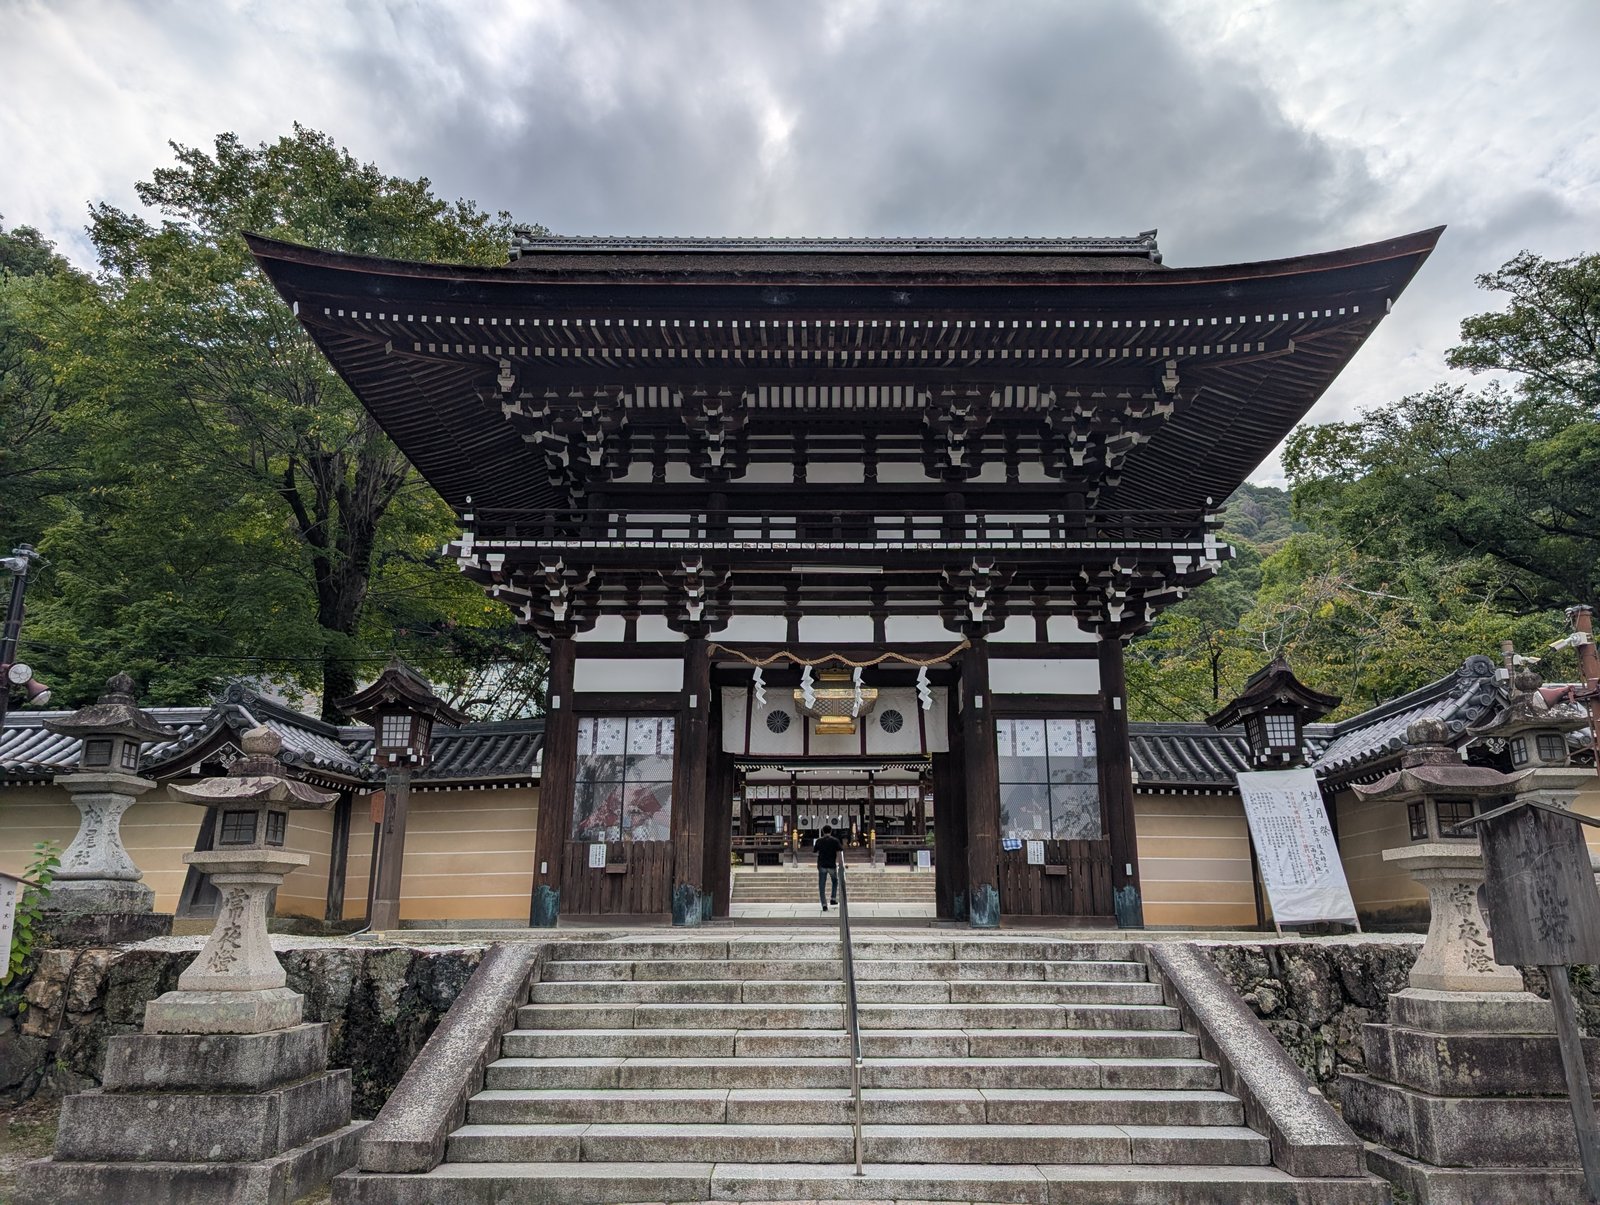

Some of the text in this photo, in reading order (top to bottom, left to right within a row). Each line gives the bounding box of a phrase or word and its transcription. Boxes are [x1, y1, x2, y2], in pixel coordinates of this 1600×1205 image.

[207, 887, 250, 974] 常夜燈
[1450, 882, 1495, 974] 常夜燈
